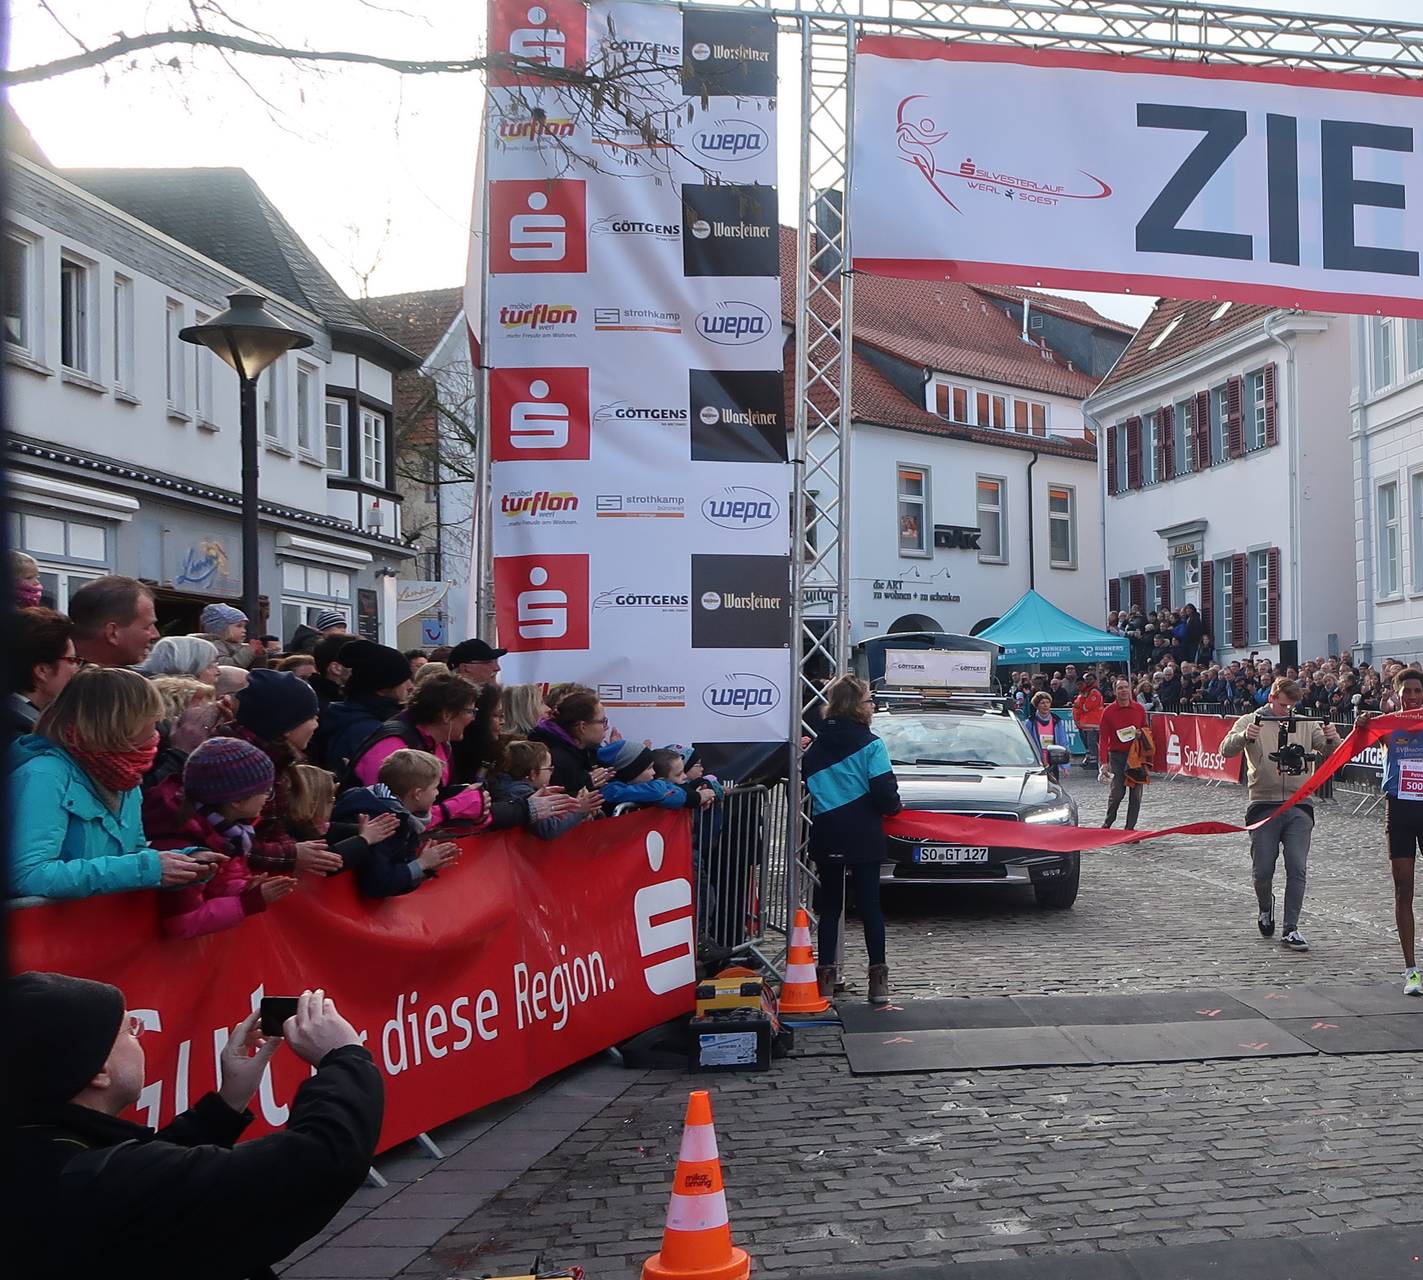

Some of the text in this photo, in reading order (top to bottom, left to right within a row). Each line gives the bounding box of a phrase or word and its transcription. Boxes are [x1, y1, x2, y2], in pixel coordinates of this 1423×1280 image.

[701, 132, 760, 154] wepa
[975, 167, 1065, 194] SILVESTERLAUF
[967, 181, 1060, 207] WERL SOEST
[612, 220, 680, 235] GÖTTGENS
[713, 223, 770, 240] Warsteiner
[500, 304, 577, 329] turflon
[624, 309, 680, 321] strothkamp
[703, 313, 764, 338] wepa
[615, 406, 687, 420] GÖTTGENS
[722, 408, 777, 427] Warsteiner
[501, 491, 579, 517] turflon
[626, 495, 685, 505] strothkamp
[709, 500, 772, 523] wepa
[934, 524, 981, 550] DAK
[615, 593, 689, 606] GÖTTGENS
[723, 591, 782, 610] Warsteiner
[626, 684, 686, 694] strothkamp
[710, 688, 773, 710] wepa
[921, 848, 987, 860] SO GT 127
[382, 991, 500, 1077] diese
[513, 944, 616, 1033] Region.
